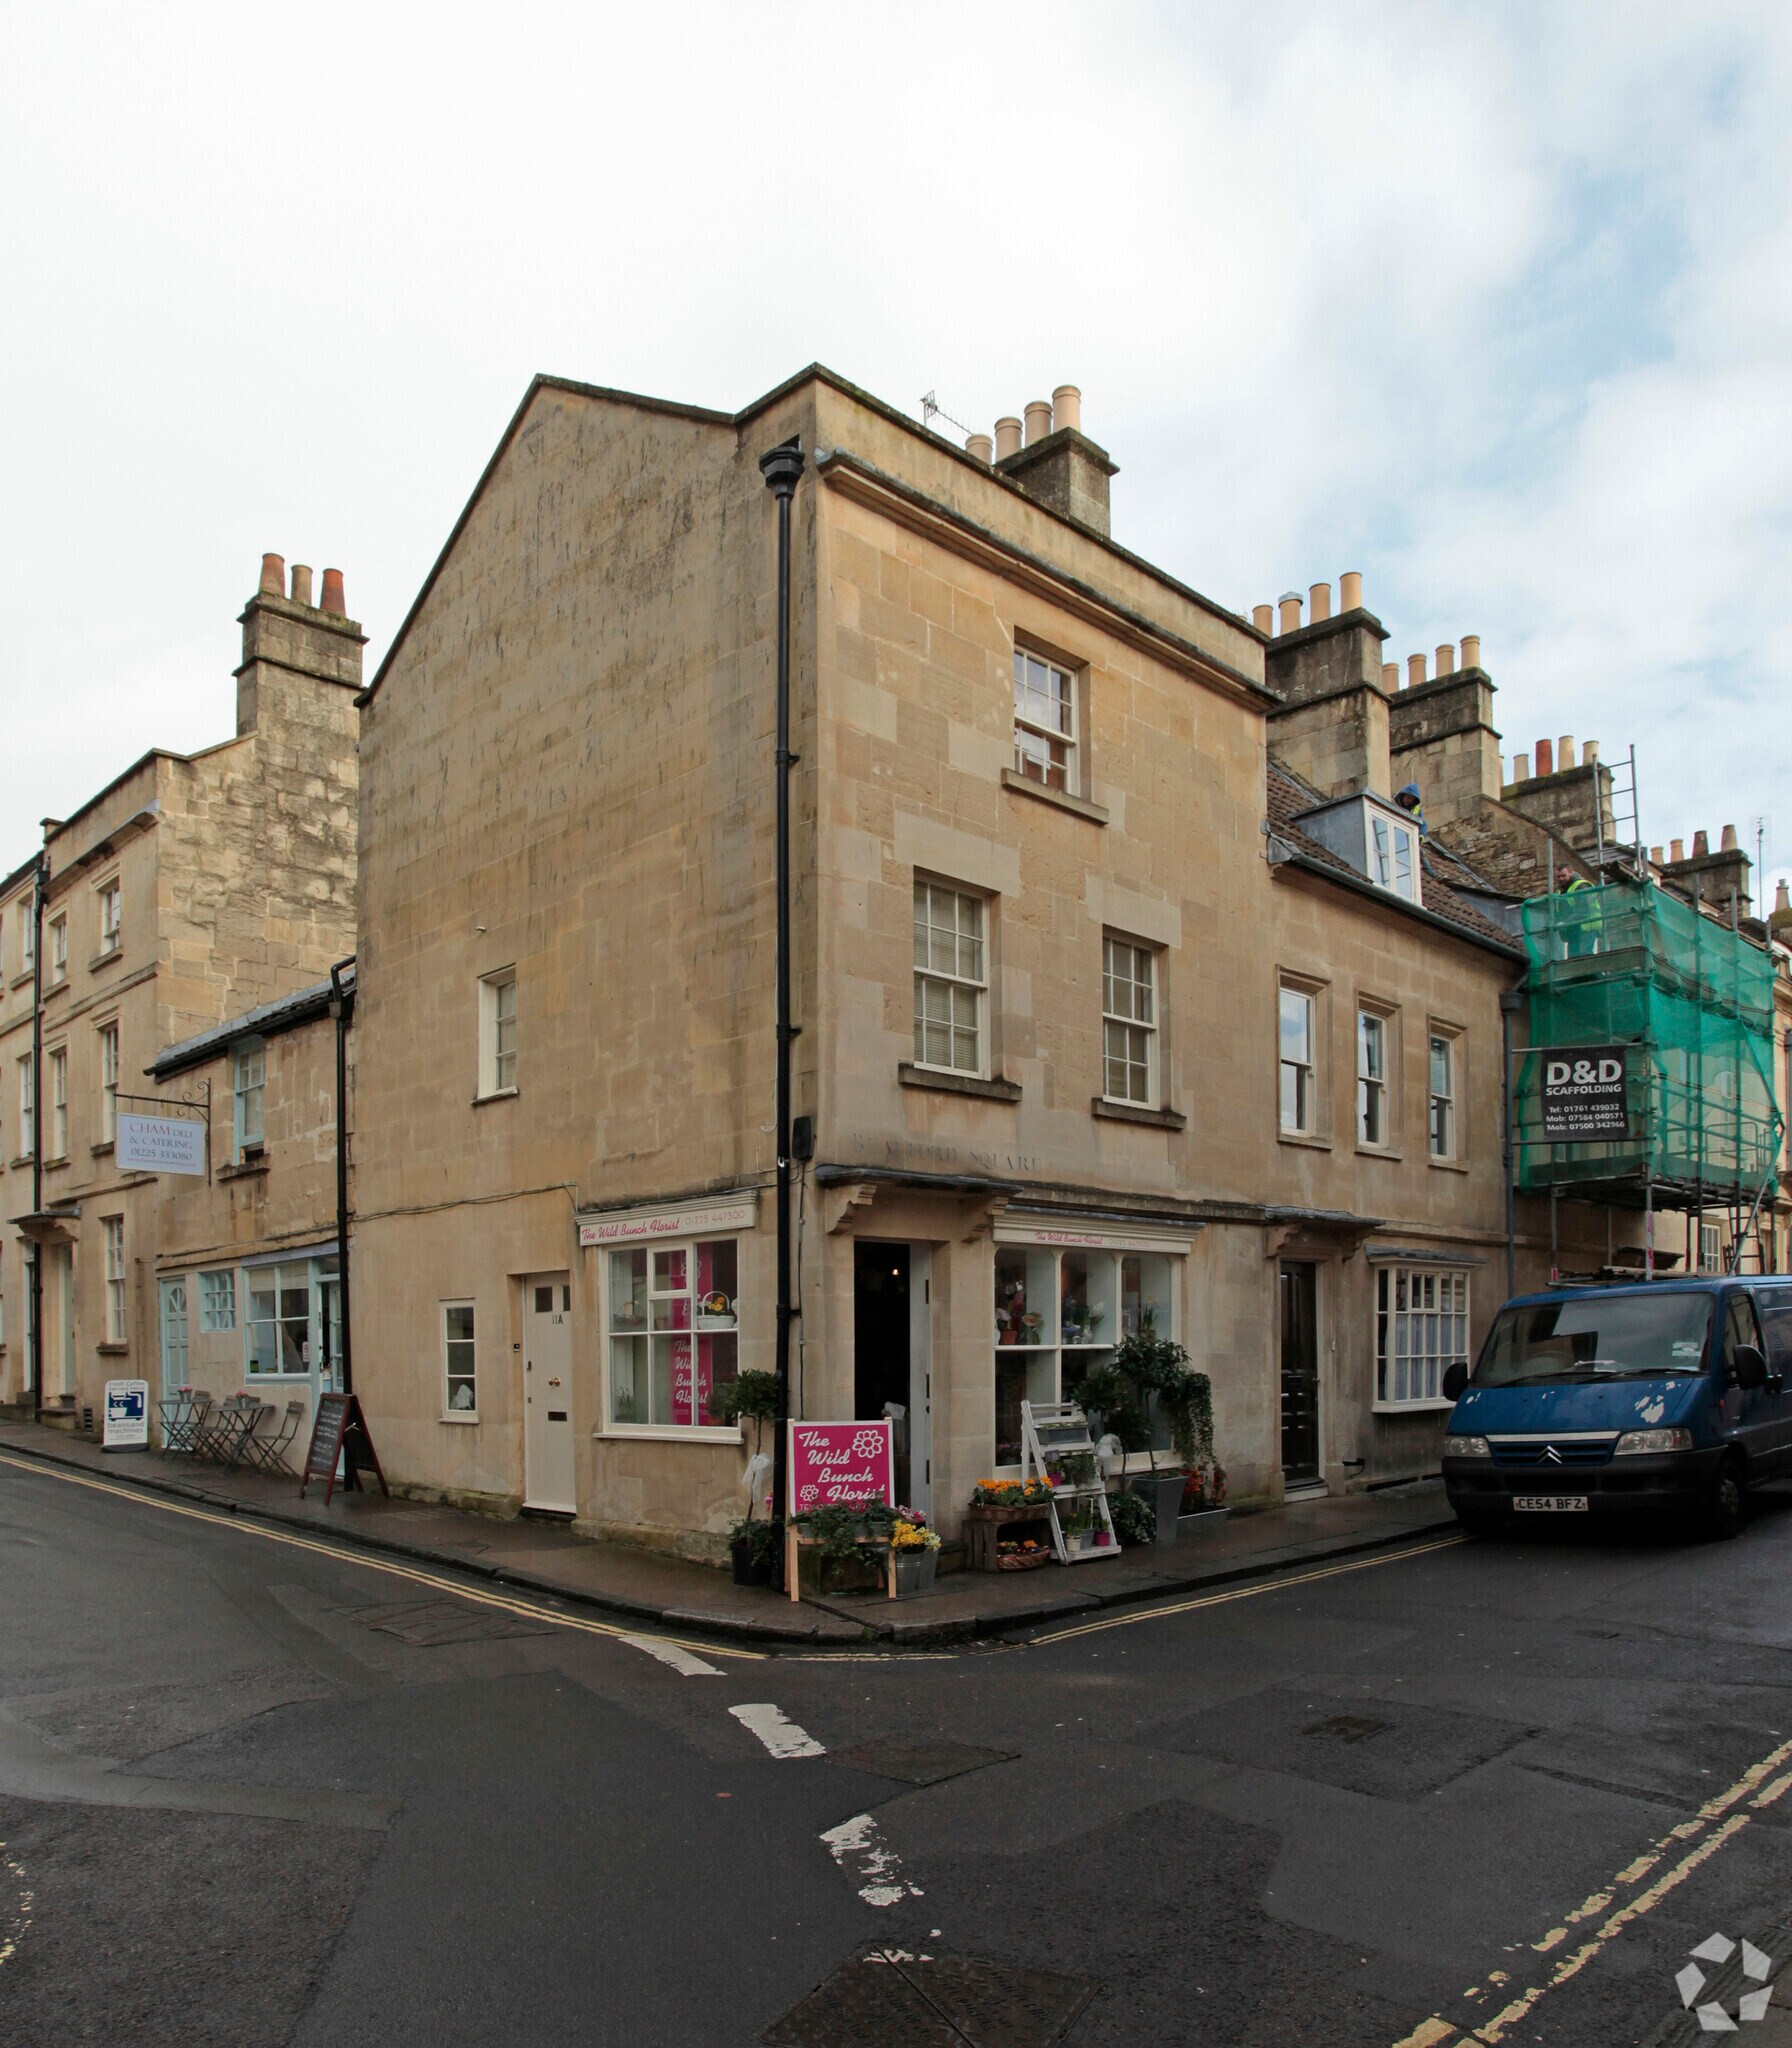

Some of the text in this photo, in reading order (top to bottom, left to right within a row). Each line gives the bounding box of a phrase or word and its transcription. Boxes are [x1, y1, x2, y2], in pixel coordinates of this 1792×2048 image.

[1546, 1060, 1622, 1086] D&D
[1546, 1084, 1622, 1096] SCAFFOLDING
[1563, 1104, 1588, 1113] 01761
[1590, 1103, 1620, 1111] 439032
[1594, 1112, 1624, 1120] 040571
[130, 1122, 193, 1138] CHAM DELI
[1569, 1122, 1594, 1130] 07500
[129, 1135, 192, 1149] & CATERING
[131, 1148, 192, 1161] 01225 333080
[581, 1209, 746, 1240] The Wild Bunch Florist 01225 447300
[1034, 1231, 1046, 1241] The
[1047, 1231, 1062, 1242] Wild
[1063, 1232, 1082, 1243] Bunch
[798, 1430, 830, 1448] The
[807, 1448, 851, 1465] Wild
[817, 1466, 874, 1483] Bunch
[1519, 1498, 1583, 1509] CE54 BFZ
